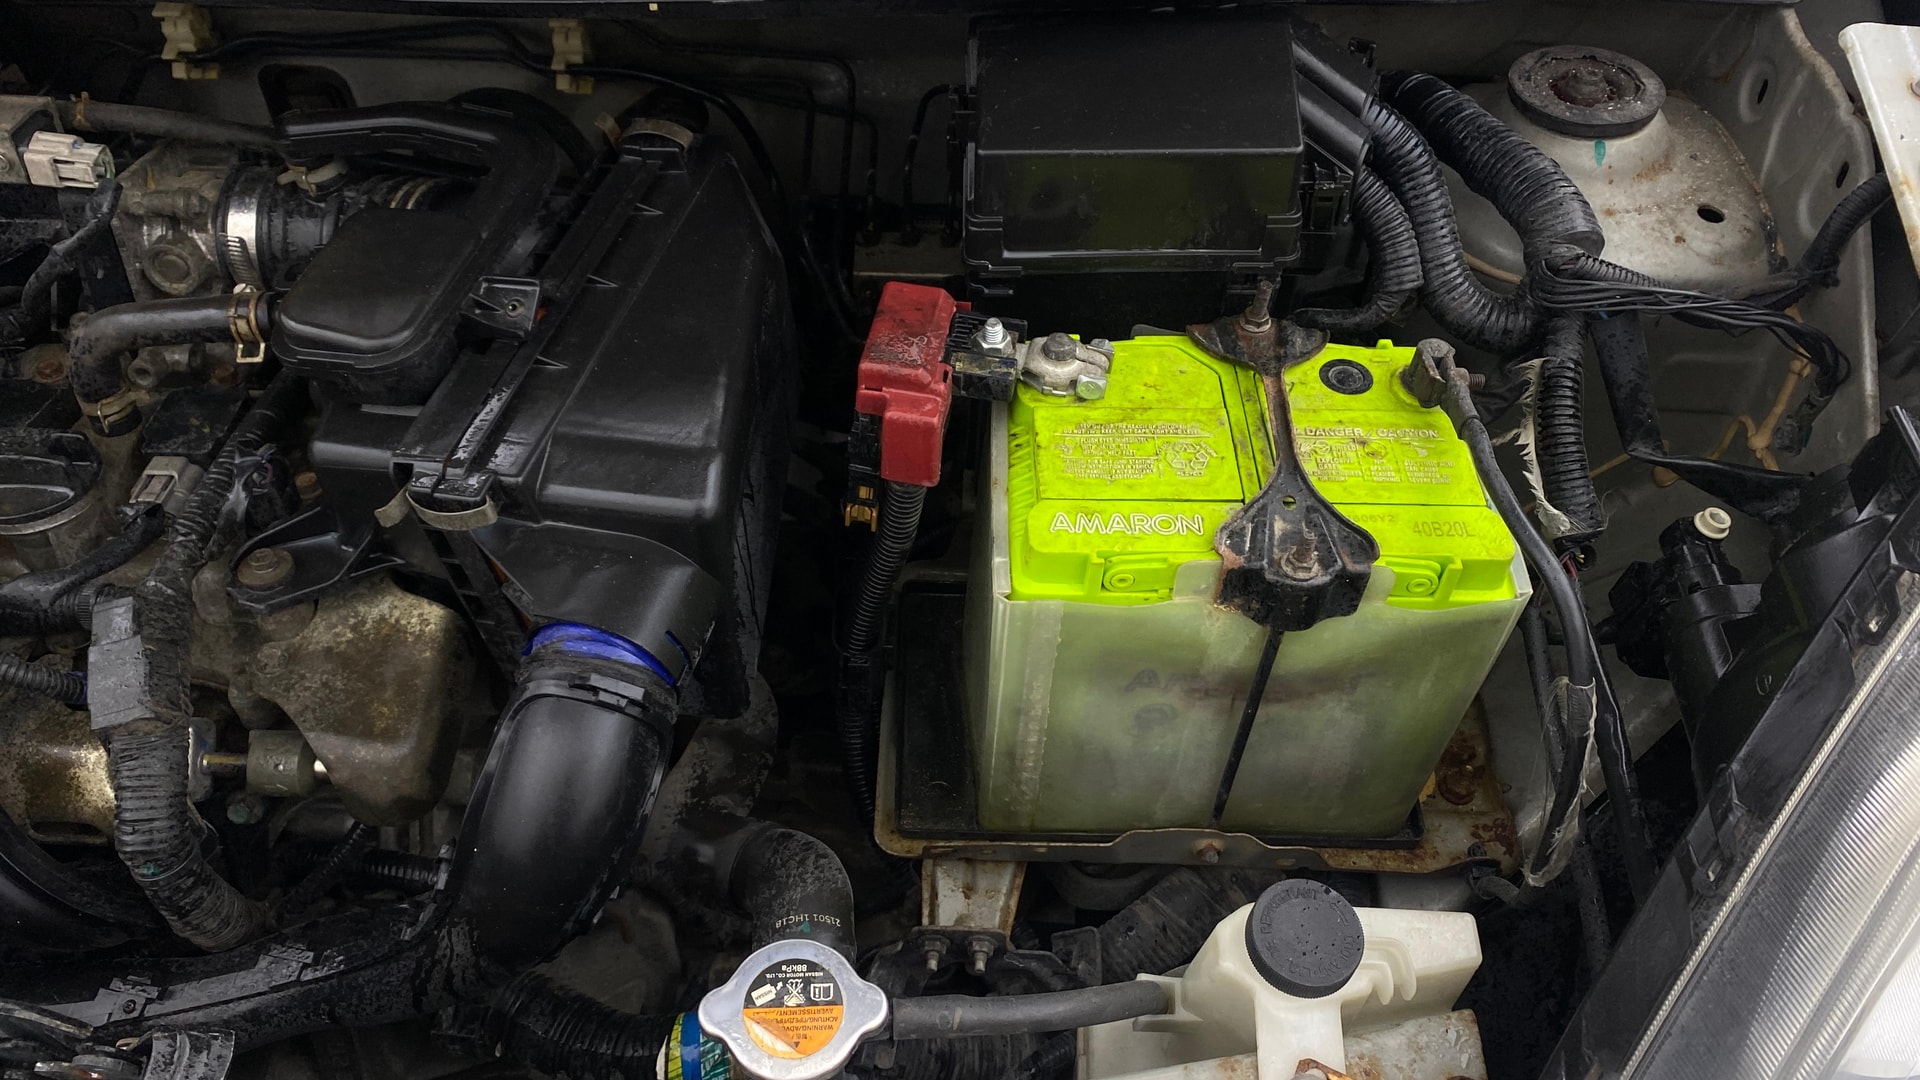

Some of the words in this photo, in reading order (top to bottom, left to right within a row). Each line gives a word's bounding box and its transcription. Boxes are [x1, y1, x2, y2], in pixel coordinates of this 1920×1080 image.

[1304, 427, 1364, 437] DANGER
[1377, 428, 1439, 438] CAUTION
[1050, 512, 1204, 535] AMARON
[1412, 521, 1477, 537] 40B20L
[812, 913, 841, 927] 21501
[781, 964, 808, 972] 88kPa
